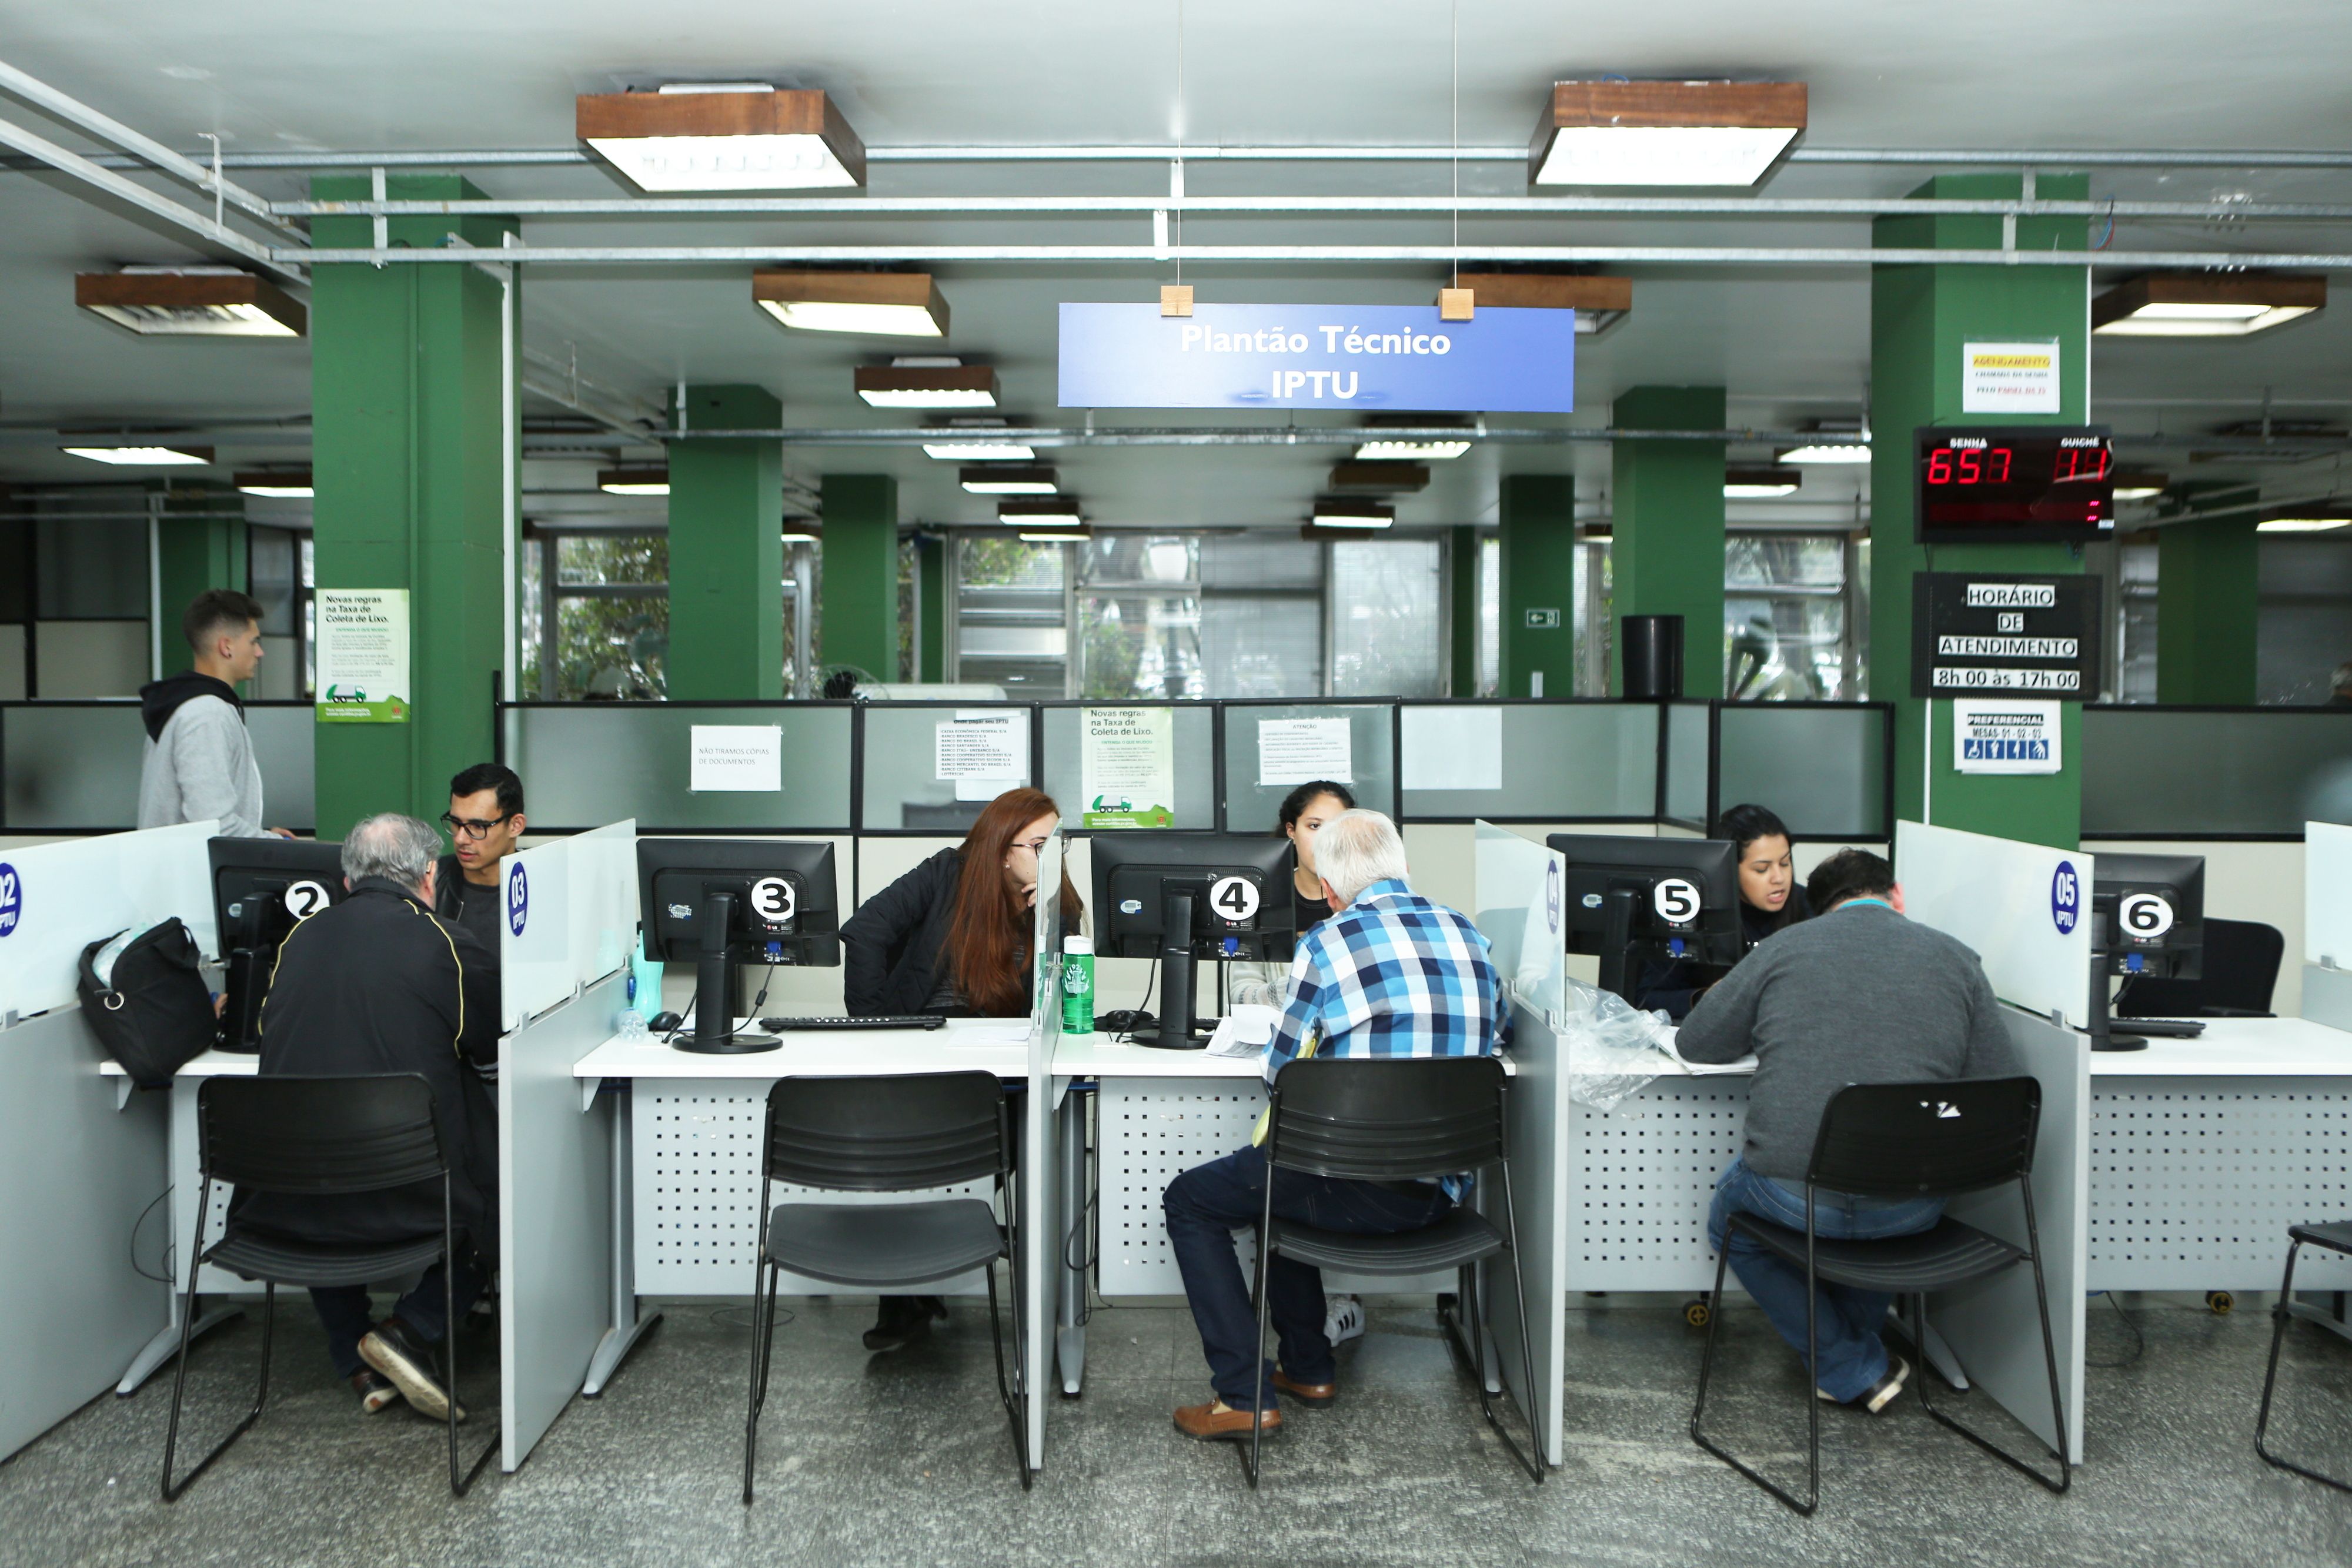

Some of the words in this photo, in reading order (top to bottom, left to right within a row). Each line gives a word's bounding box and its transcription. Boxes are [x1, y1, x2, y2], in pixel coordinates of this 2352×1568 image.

[1181, 323, 1309, 354] Plantão
[1319, 325, 1452, 356] Técnico
[1973, 357, 2050, 366] AGENDAMENTO
[1272, 370, 1359, 399] IPTU
[1950, 437, 1987, 449] SENHA
[1927, 449, 2012, 484] 657
[326, 595, 352, 604] Novas
[354, 597, 382, 606] regras
[1969, 586, 2053, 605] HORÁRIO
[326, 614, 353, 623] Coleta
[355, 614, 366, 623] de
[368, 614, 389, 623] Lixo.
[338, 605, 358, 613] Taxa
[360, 605, 371, 613] de
[1999, 616, 2022, 630] DE
[1941, 638, 2076, 655] ATENDIMENTO
[1939, 670, 1959, 686] 8h
[1966, 671, 1986, 686] 00
[1993, 668, 2010, 686] às
[2020, 672, 2050, 687] 17h
[2057, 673, 2077, 688] 00
[1968, 716, 2043, 725] PREFERENCIAL
[2002, 728, 2010, 738] 01
[2017, 728, 2026, 738] 02
[2033, 728, 2042, 738] 03
[746, 747, 769, 755] CÓPIAS
[511, 871, 525, 909] 03
[1219, 882, 1248, 913] 4
[1548, 870, 1558, 906] 04
[2056, 871, 2076, 907] 05
[298, 886, 319, 917] 2
[762, 883, 791, 914] 3
[1665, 885, 1692, 916] 5
[513, 909, 525, 930] IPTU
[2056, 910, 2074, 927] IPTU
[2129, 900, 2159, 930] 6
